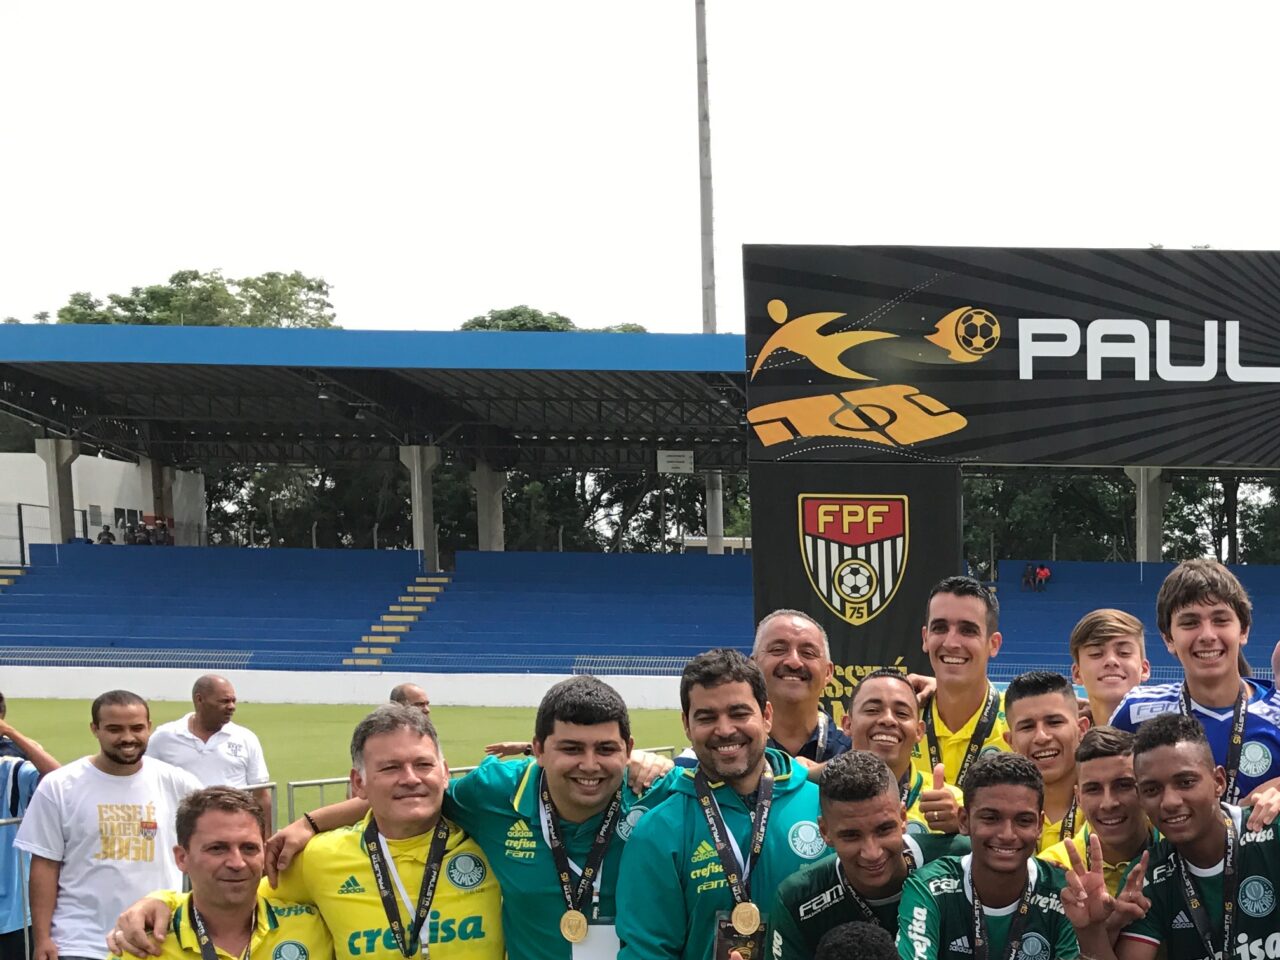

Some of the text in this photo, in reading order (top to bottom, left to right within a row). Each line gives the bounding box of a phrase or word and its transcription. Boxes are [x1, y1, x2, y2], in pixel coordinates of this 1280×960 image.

[817, 504, 890, 534] FPF
[848, 606, 865, 619] 75
[1238, 698, 1247, 733] PAULISTA
[600, 800, 619, 838] PAULISTA
[504, 838, 537, 850] crefisa
[507, 829, 534, 838] adidas
[449, 866, 484, 888] PALMEIRAS
[1179, 859, 1195, 898] PAULISTA
[337, 886, 366, 894] adidas
[1241, 888, 1275, 914] PALMEIRAS
[1171, 920, 1194, 929] adidas
[1224, 914, 1232, 952] PAULISTA
